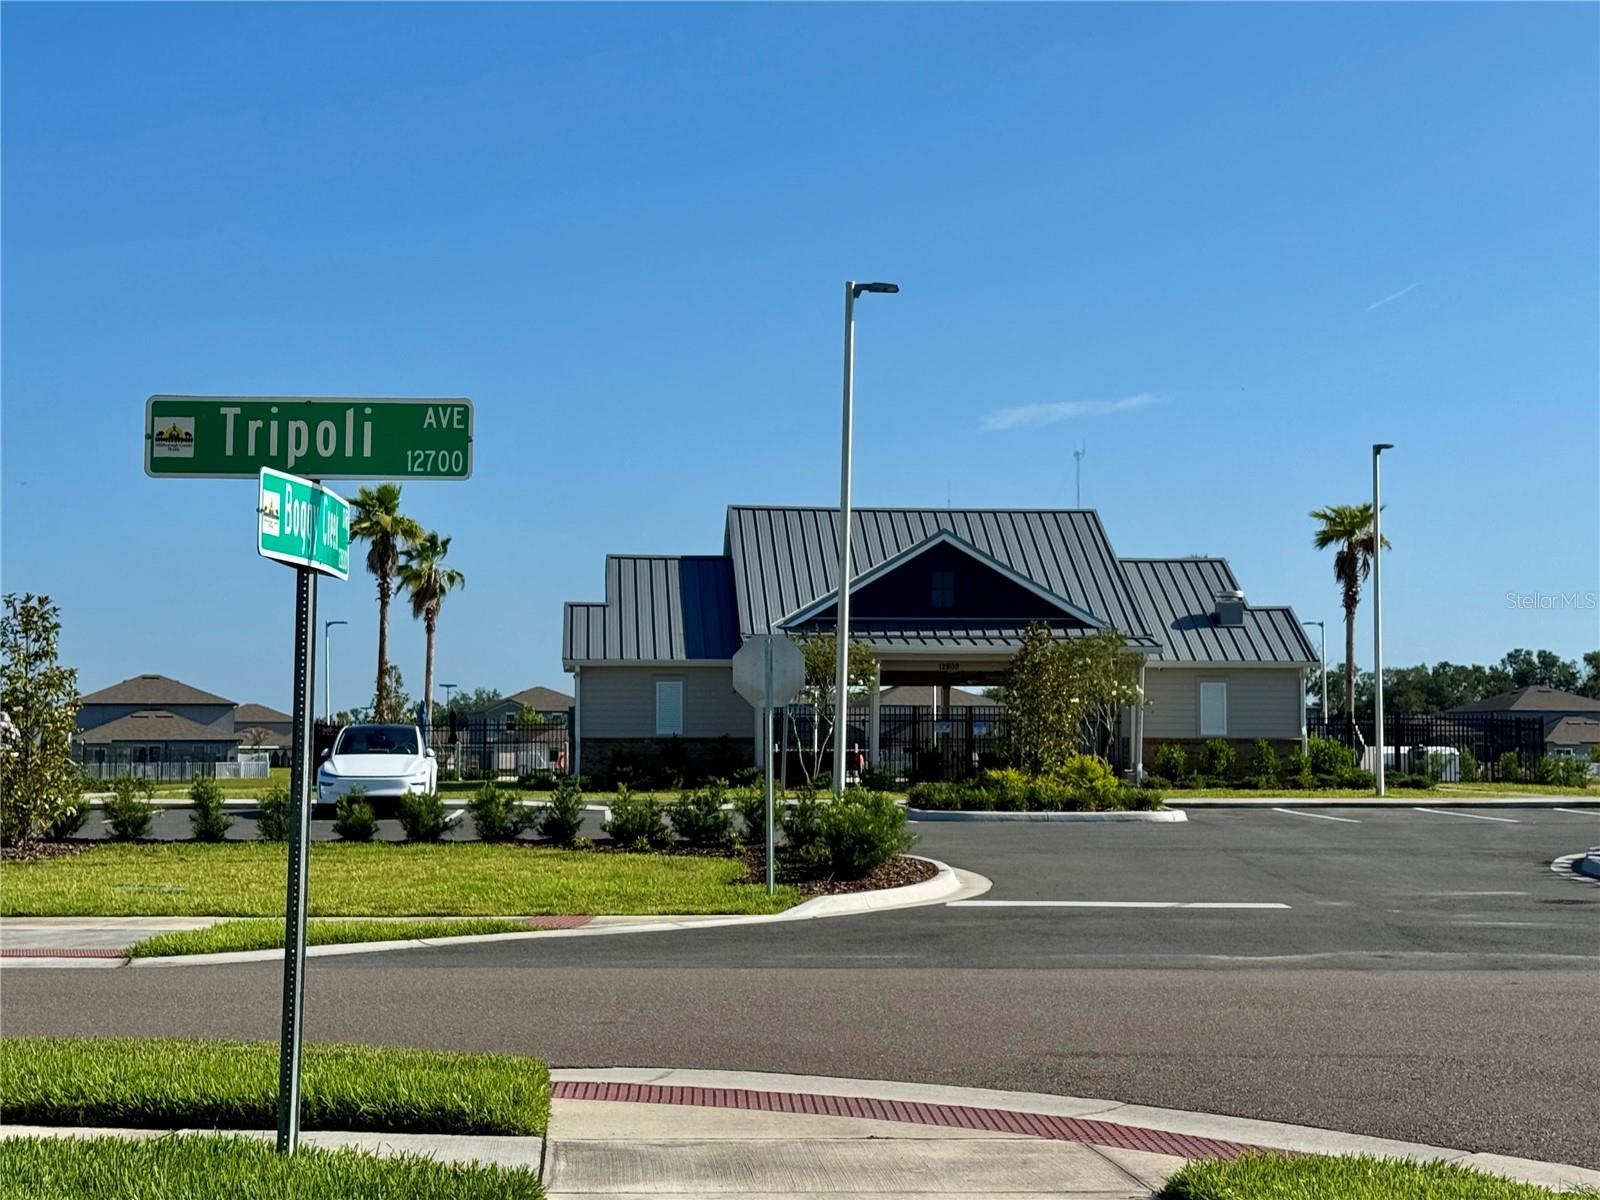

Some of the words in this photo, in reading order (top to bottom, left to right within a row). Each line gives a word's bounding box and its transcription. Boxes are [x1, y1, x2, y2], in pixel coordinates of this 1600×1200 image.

[219, 406, 373, 469] Tripoli
[424, 406, 465, 429] AVE
[406, 450, 464, 473] 12700
[284, 482, 320, 556] Boggy
